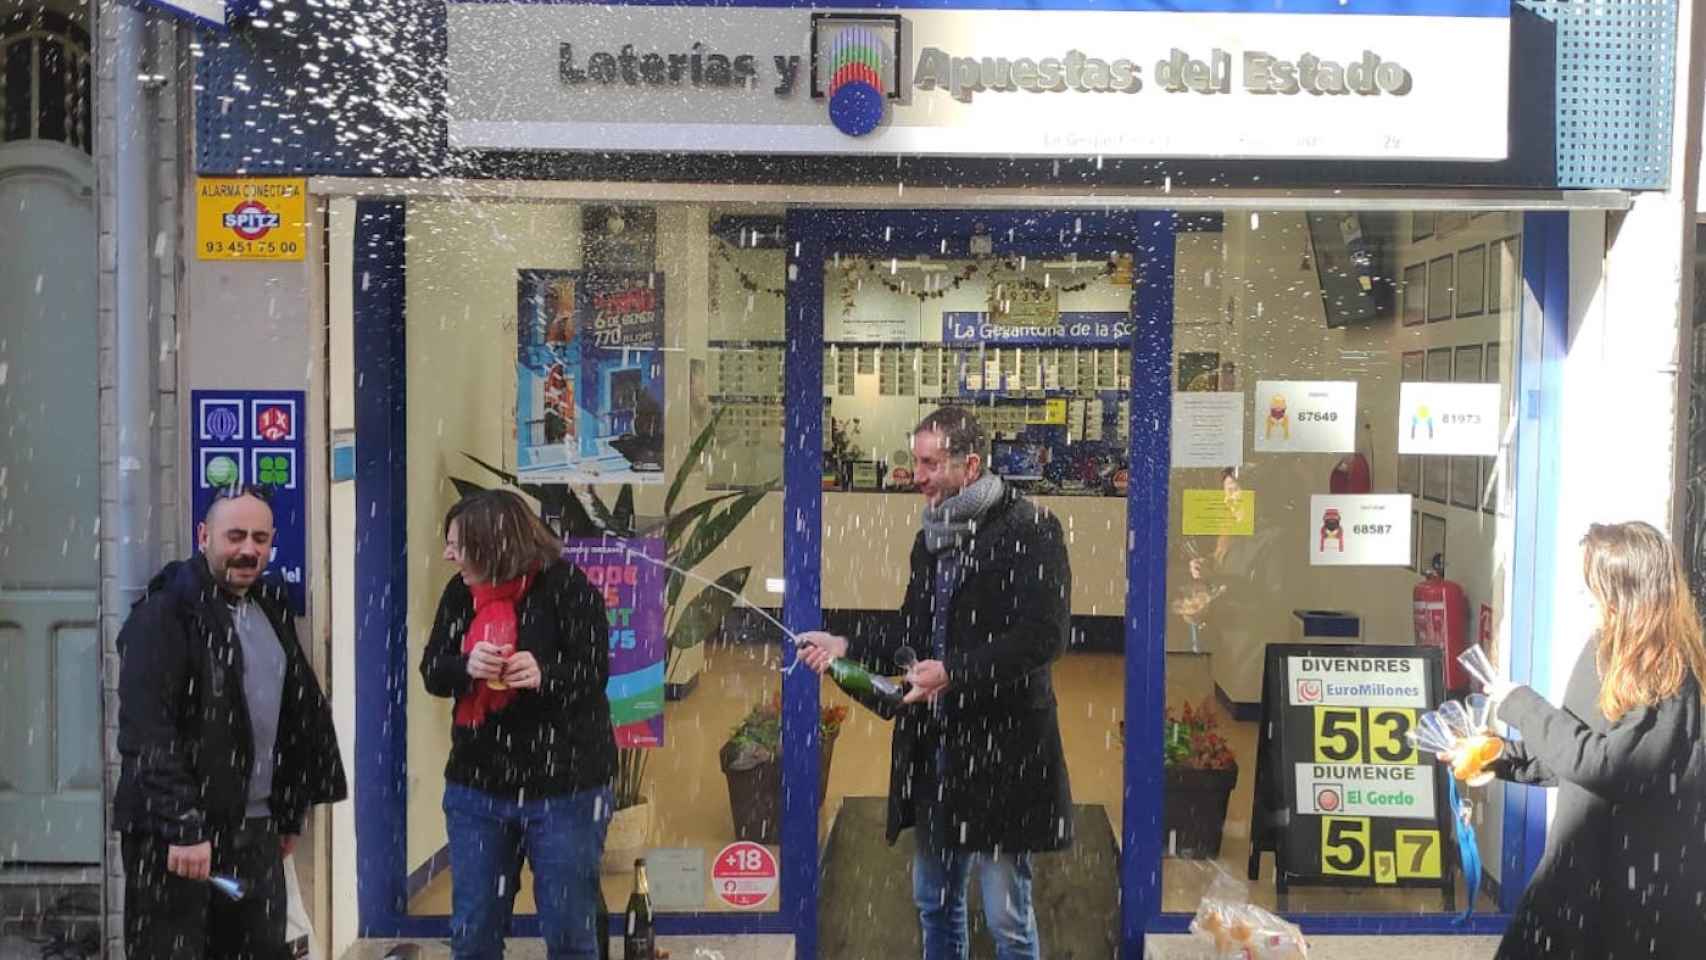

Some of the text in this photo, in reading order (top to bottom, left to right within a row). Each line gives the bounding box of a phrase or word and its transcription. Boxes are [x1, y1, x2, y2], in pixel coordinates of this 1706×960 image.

[558, 41, 1413, 102] Loterías y Apuestas del Estado
[201, 184, 299, 198] ALARMA CONECTADA
[225, 214, 278, 228] SPITZ
[206, 241, 223, 253] 93
[228, 241, 252, 253] 451
[280, 241, 297, 253] 00
[594, 326, 621, 347] 770
[954, 323, 975, 339] La
[1070, 320, 1091, 337] de
[1095, 321, 1109, 337] la
[1302, 658, 1410, 673] DIVENDRES
[1326, 684, 1419, 697] EuroMillones
[1319, 711, 1415, 762] 53
[1313, 765, 1416, 781] DIUMENGE
[1347, 791, 1415, 806] El Gordo
[725, 848, 762, 871] +18
